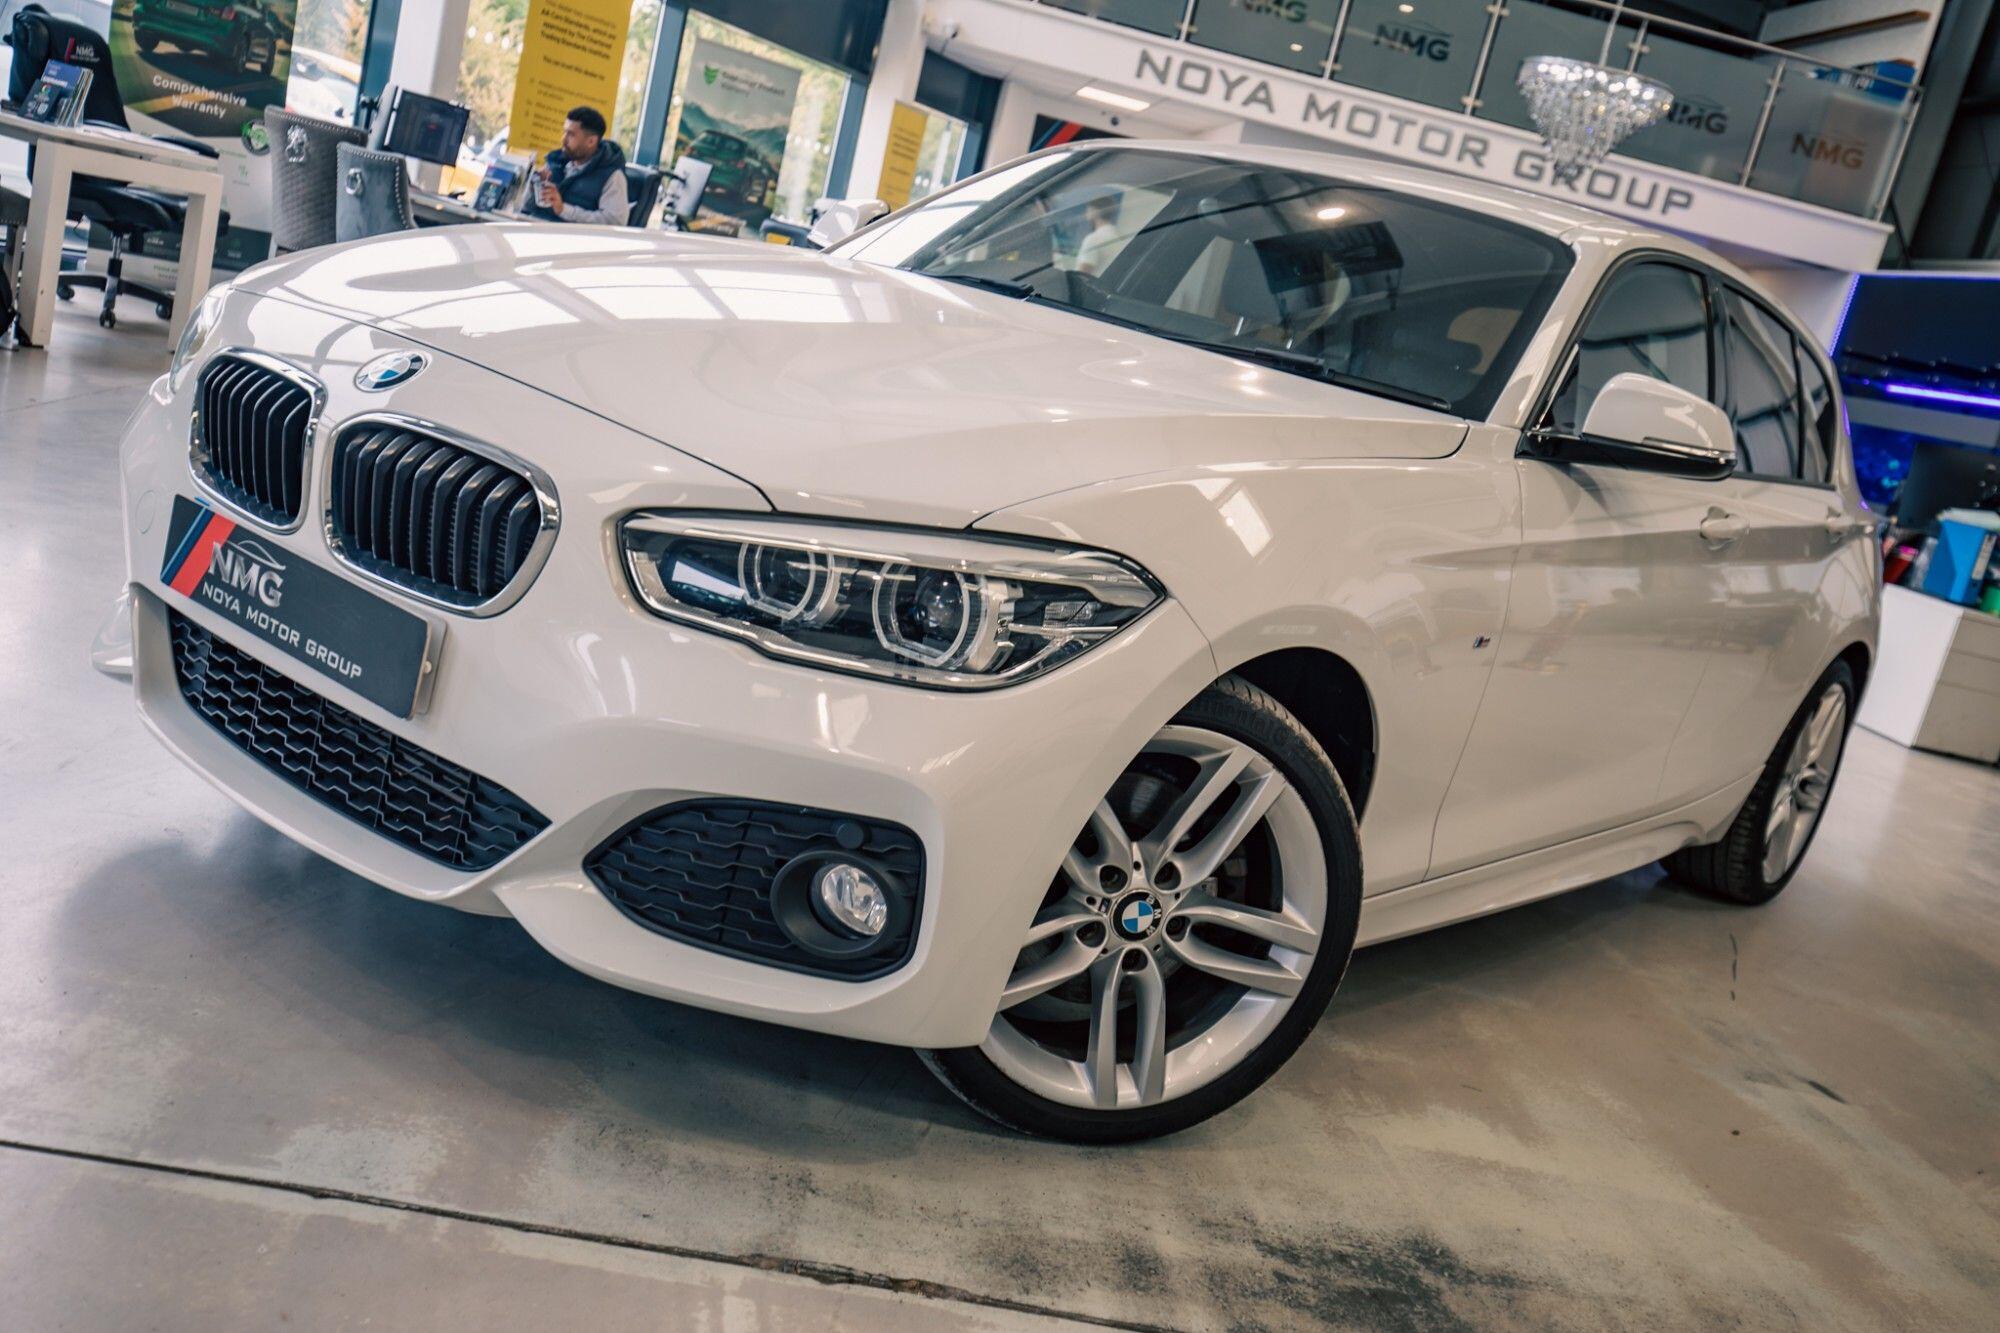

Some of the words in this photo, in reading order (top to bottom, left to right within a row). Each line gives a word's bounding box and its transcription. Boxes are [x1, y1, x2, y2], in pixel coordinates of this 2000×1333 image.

[1373, 24, 1451, 62] NMG
[152, 74, 247, 107] Comprehensive
[172, 94, 227, 119] Warranty
[1135, 48, 1276, 114] NOYA
[1302, 92, 1490, 169] MOTOR
[1514, 150, 1694, 215] GROUP
[1791, 131, 1865, 170] NMG
[208, 541, 284, 608] NMG
[202, 581, 241, 615] NOYA
[246, 605, 301, 648] MOTOR
[305, 638, 363, 679] GROUP
